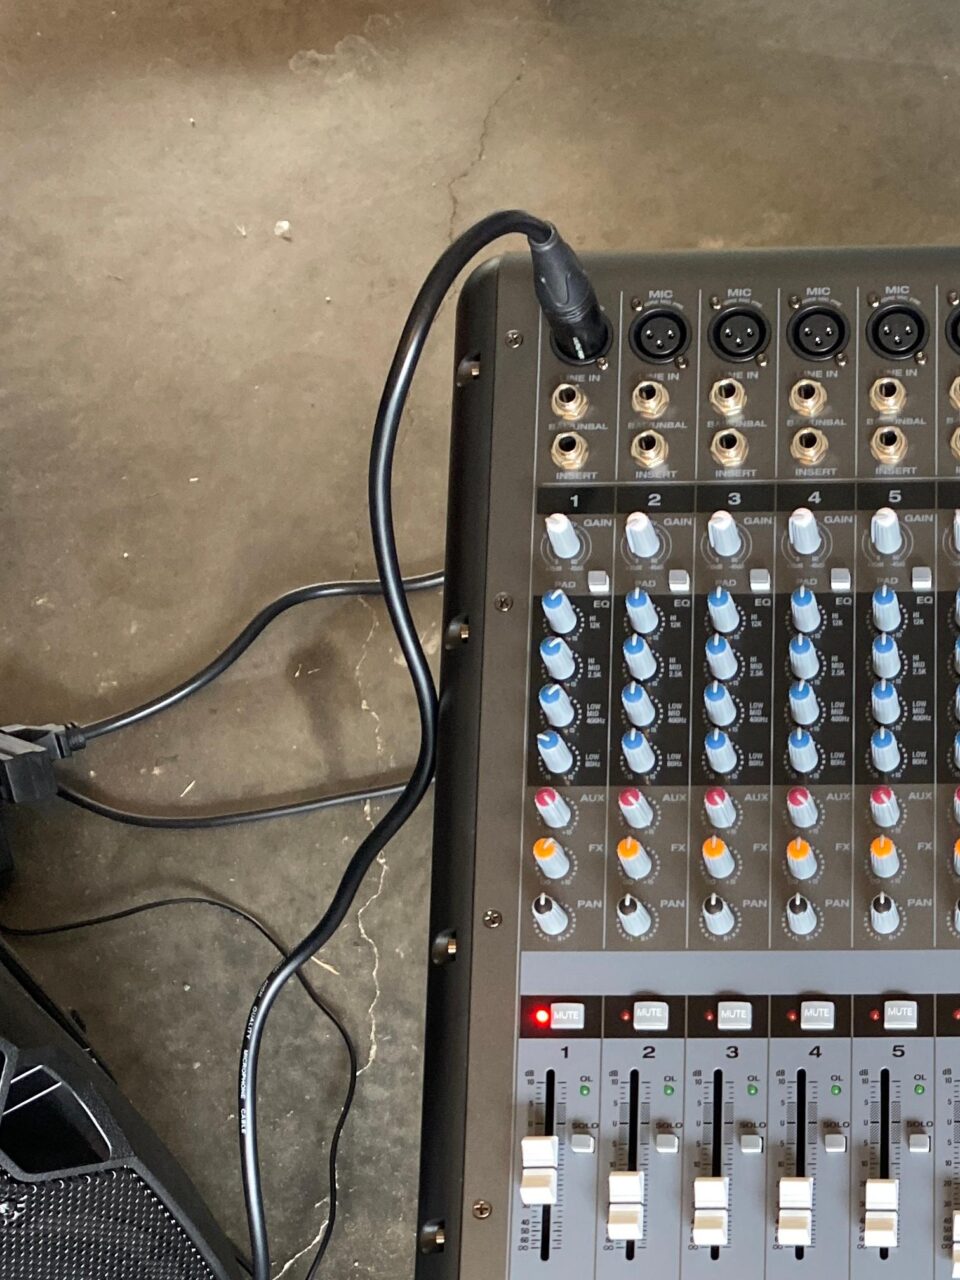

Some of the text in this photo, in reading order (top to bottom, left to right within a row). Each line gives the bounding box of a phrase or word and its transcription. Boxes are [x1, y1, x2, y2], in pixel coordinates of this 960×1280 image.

[727, 288, 752, 297] MIC
[806, 287, 831, 296] MIC
[885, 285, 910, 294] MIC
[649, 290, 673, 299] MIC
[668, 373, 679, 381] IN
[826, 370, 838, 378] IN
[906, 368, 917, 377] IN
[589, 374, 600, 382] IN
[635, 470, 678, 479] INSERT
[715, 469, 757, 477] INSERT
[795, 468, 837, 476] INSERT
[875, 466, 917, 475] INSERT
[570, 494, 579, 507] 1
[647, 493, 662, 506] 2
[727, 492, 741, 505] 3
[807, 491, 821, 503] 4
[888, 490, 902, 502] 5
[583, 519, 612, 527] GAIN
[663, 518, 692, 526] GAIN
[743, 517, 772, 525] GAIN
[824, 516, 853, 524] GAIN
[904, 514, 934, 523] GAIN
[593, 600, 610, 609] EQ
[674, 599, 691, 608] EQ
[754, 598, 771, 607] EQ
[835, 597, 852, 606] EQ
[916, 596, 933, 605] EQ
[579, 793, 604, 802] AUX
[662, 793, 687, 802] AUX
[744, 793, 769, 801] AUX
[826, 792, 850, 801] AUX
[908, 791, 932, 800] AUX
[589, 844, 603, 852] FX
[671, 844, 686, 852] FX
[753, 844, 768, 852] FX
[835, 842, 850, 851] FX
[917, 842, 933, 850] FX
[577, 900, 602, 909] PAN
[660, 900, 685, 908] PAN
[742, 899, 767, 908] PAN
[825, 899, 849, 907] PAN
[907, 898, 932, 907] PAN
[554, 1011, 579, 1020] MUTE
[637, 1008, 662, 1017] MUTE
[721, 1009, 747, 1018] MUTE
[804, 1008, 830, 1017] MUTE
[887, 1007, 913, 1016] MUTE
[246, 1006, 258, 1040] QUALITY
[560, 1046, 569, 1059] 1
[642, 1046, 656, 1059] 2
[725, 1046, 739, 1059] 3
[808, 1046, 822, 1058] 4
[892, 1045, 905, 1057] 5
[240, 1050, 249, 1100] MICROPHONE
[580, 1075, 593, 1083] OL
[655, 1121, 683, 1129] SOLO
[739, 1121, 767, 1129] SOLO
[906, 1120, 934, 1128] SOLO
